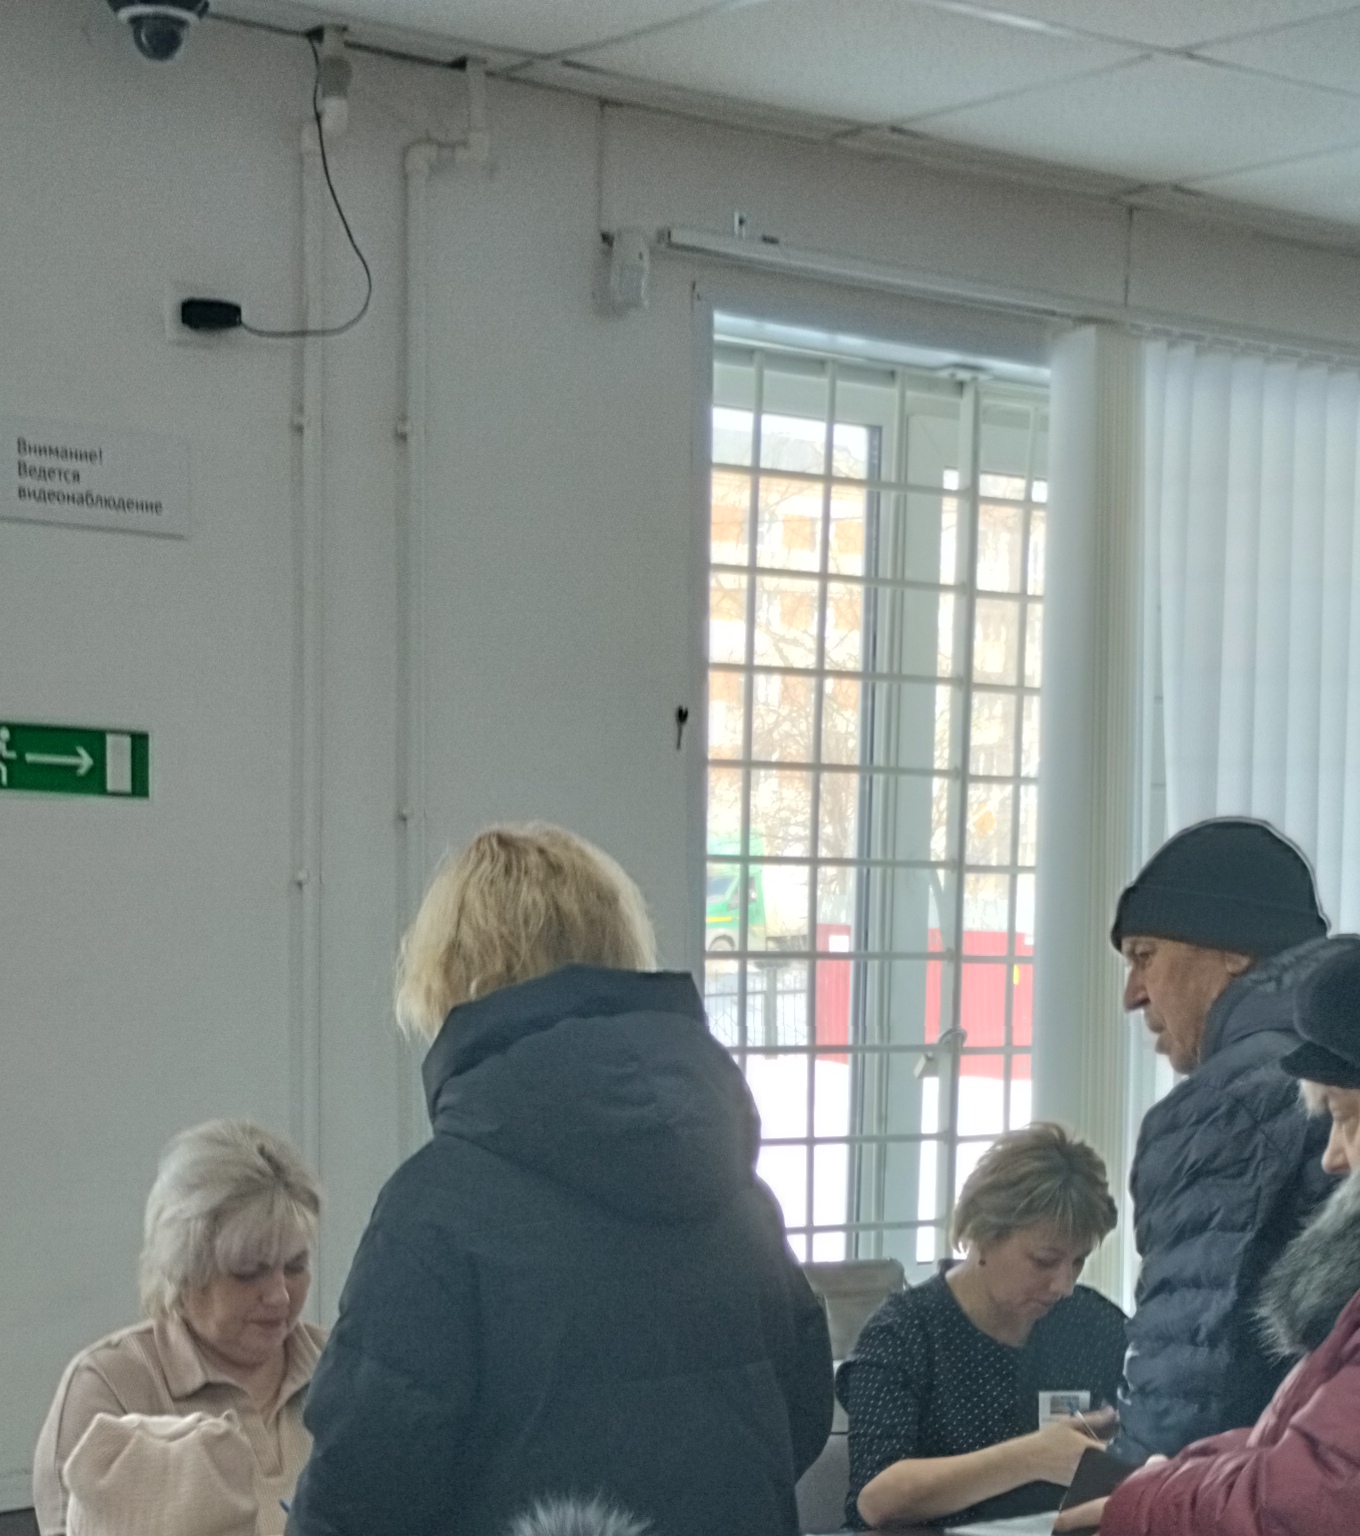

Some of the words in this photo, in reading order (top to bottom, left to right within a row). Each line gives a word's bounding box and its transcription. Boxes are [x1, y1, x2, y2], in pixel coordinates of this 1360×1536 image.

[17, 437, 102, 465] Внимание!
[18, 459, 81, 484] Ведется
[18, 485, 163, 515] видеонаблюдение
